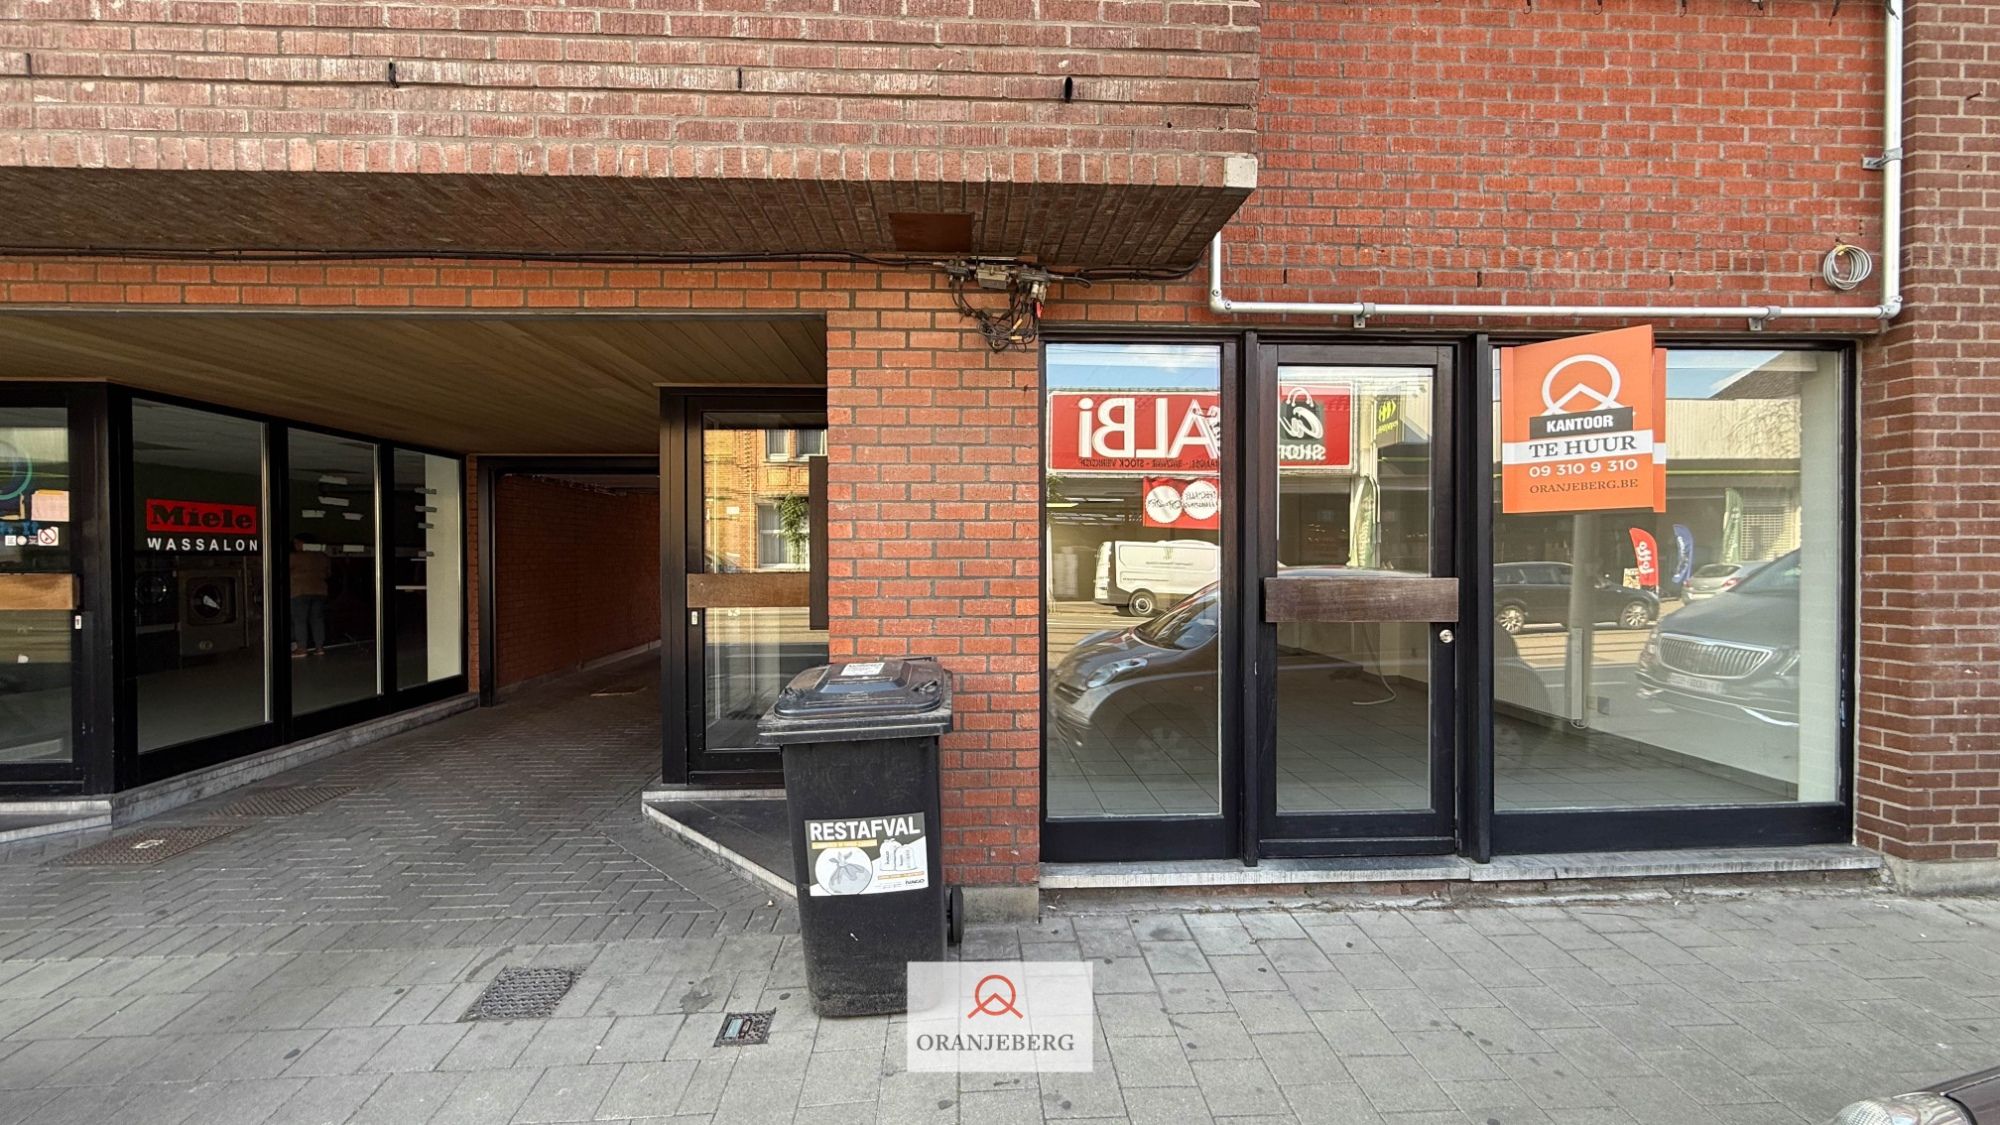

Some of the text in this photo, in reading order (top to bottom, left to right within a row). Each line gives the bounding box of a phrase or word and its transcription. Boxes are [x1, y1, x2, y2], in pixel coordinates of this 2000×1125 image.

[1546, 415, 1614, 433] KANTOOR
[1529, 435, 1637, 458] TE HUUR
[1529, 459, 1638, 478] 09 310 9 310
[1529, 479, 1639, 493] ORANJEBERG.BE
[151, 505, 253, 529] Miele
[147, 538, 258, 551] WASSALON
[810, 817, 921, 841] RESTAFVAL
